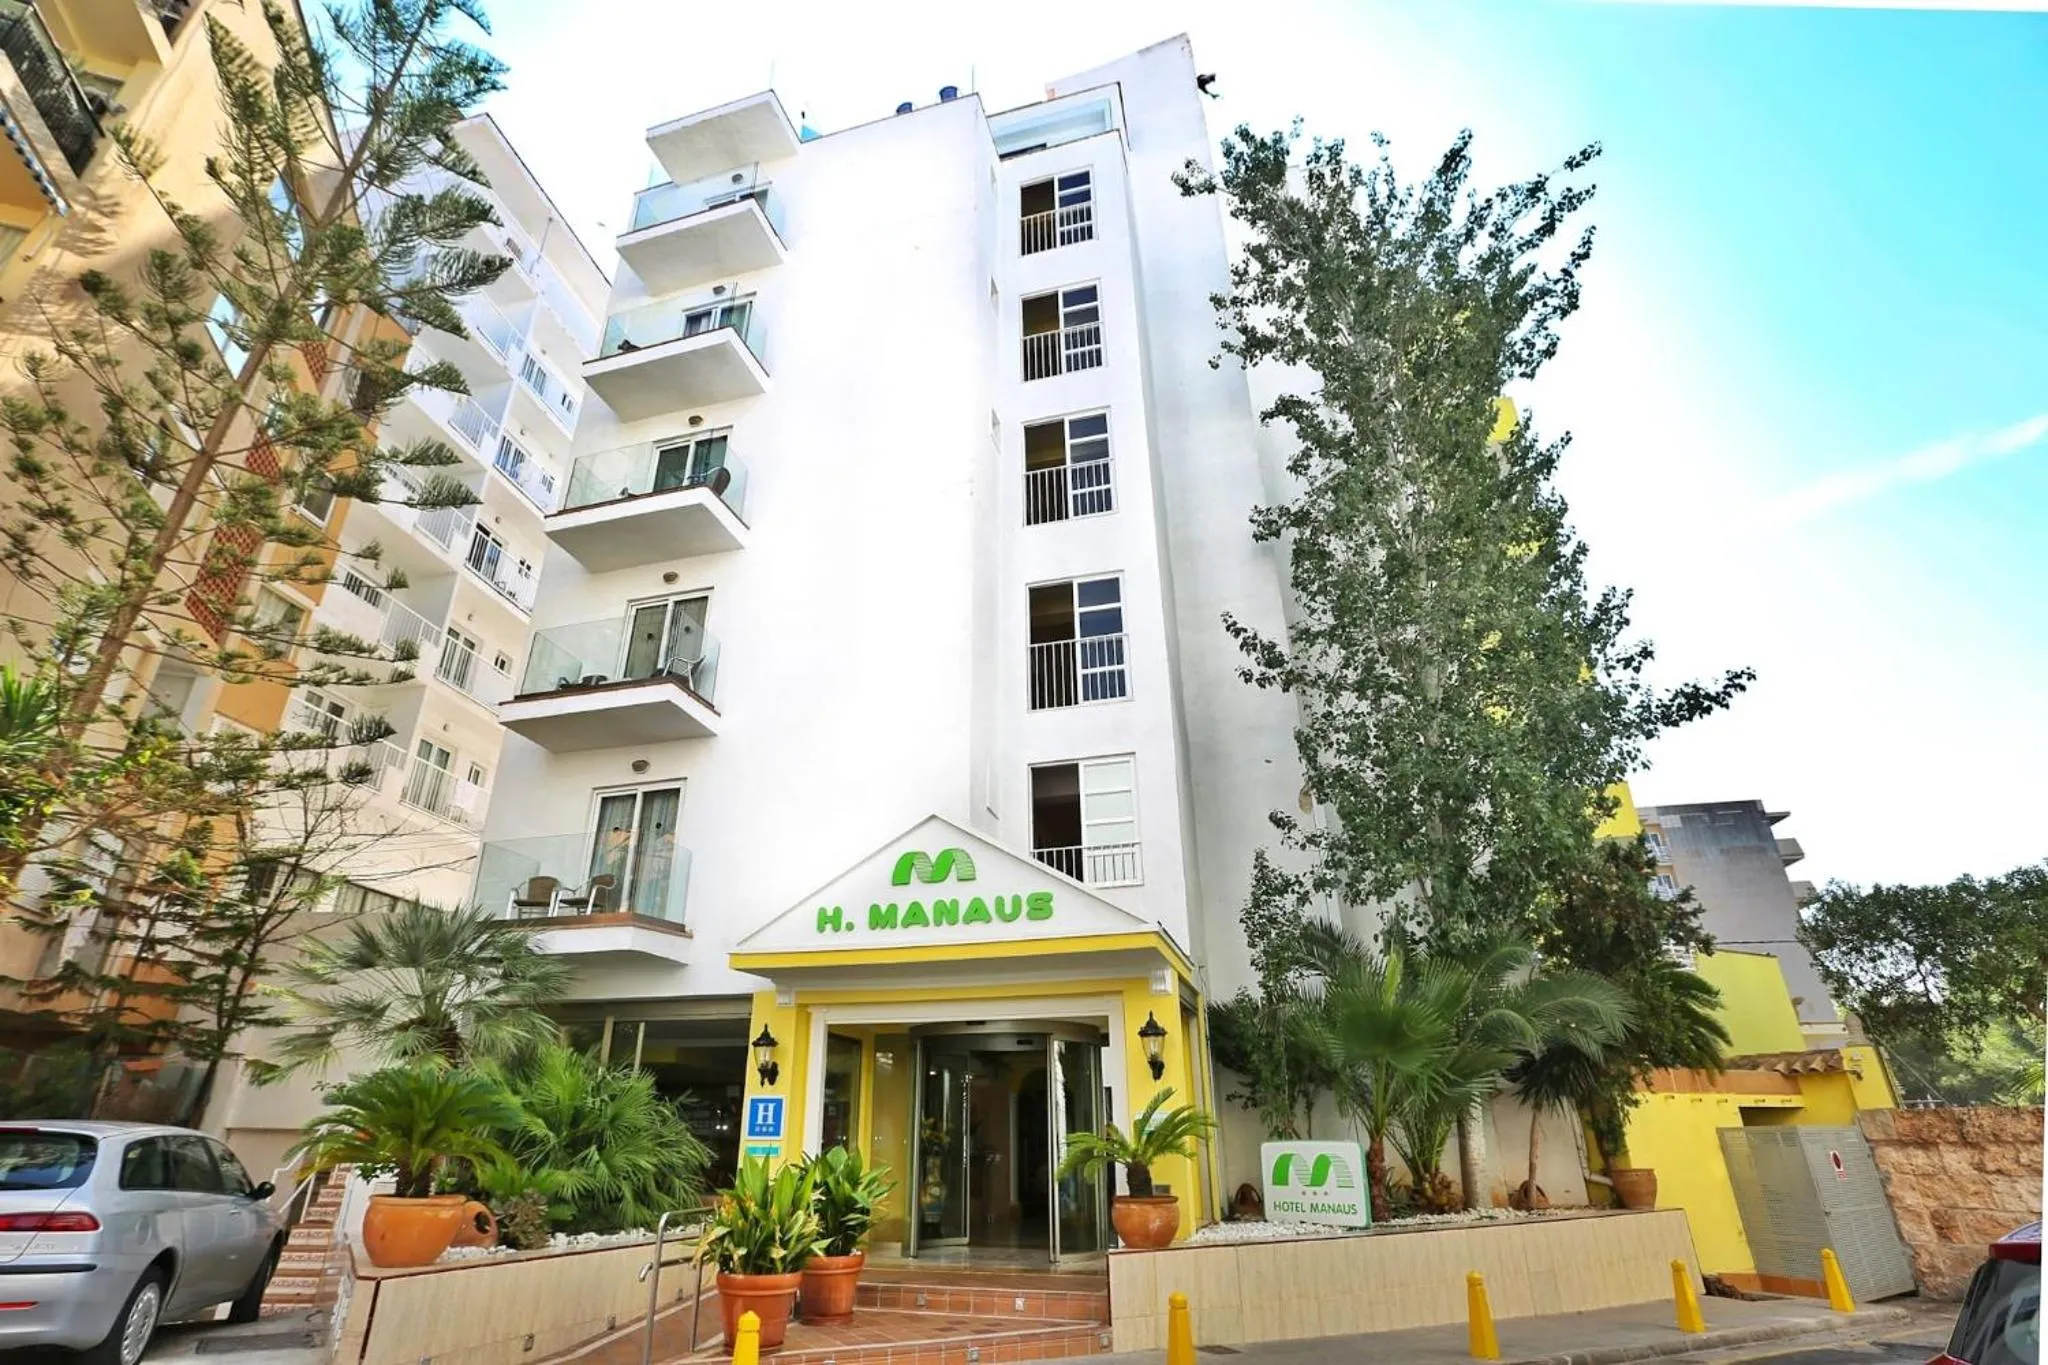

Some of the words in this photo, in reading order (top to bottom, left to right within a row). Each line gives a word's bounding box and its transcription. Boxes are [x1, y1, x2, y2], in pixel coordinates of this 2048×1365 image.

[816, 906, 855, 933] H.
[868, 891, 1054, 930] MANAUS
[755, 1102, 777, 1125] H
[1273, 1201, 1306, 1213] HOTEL
[1310, 1203, 1358, 1215] MANAUS
